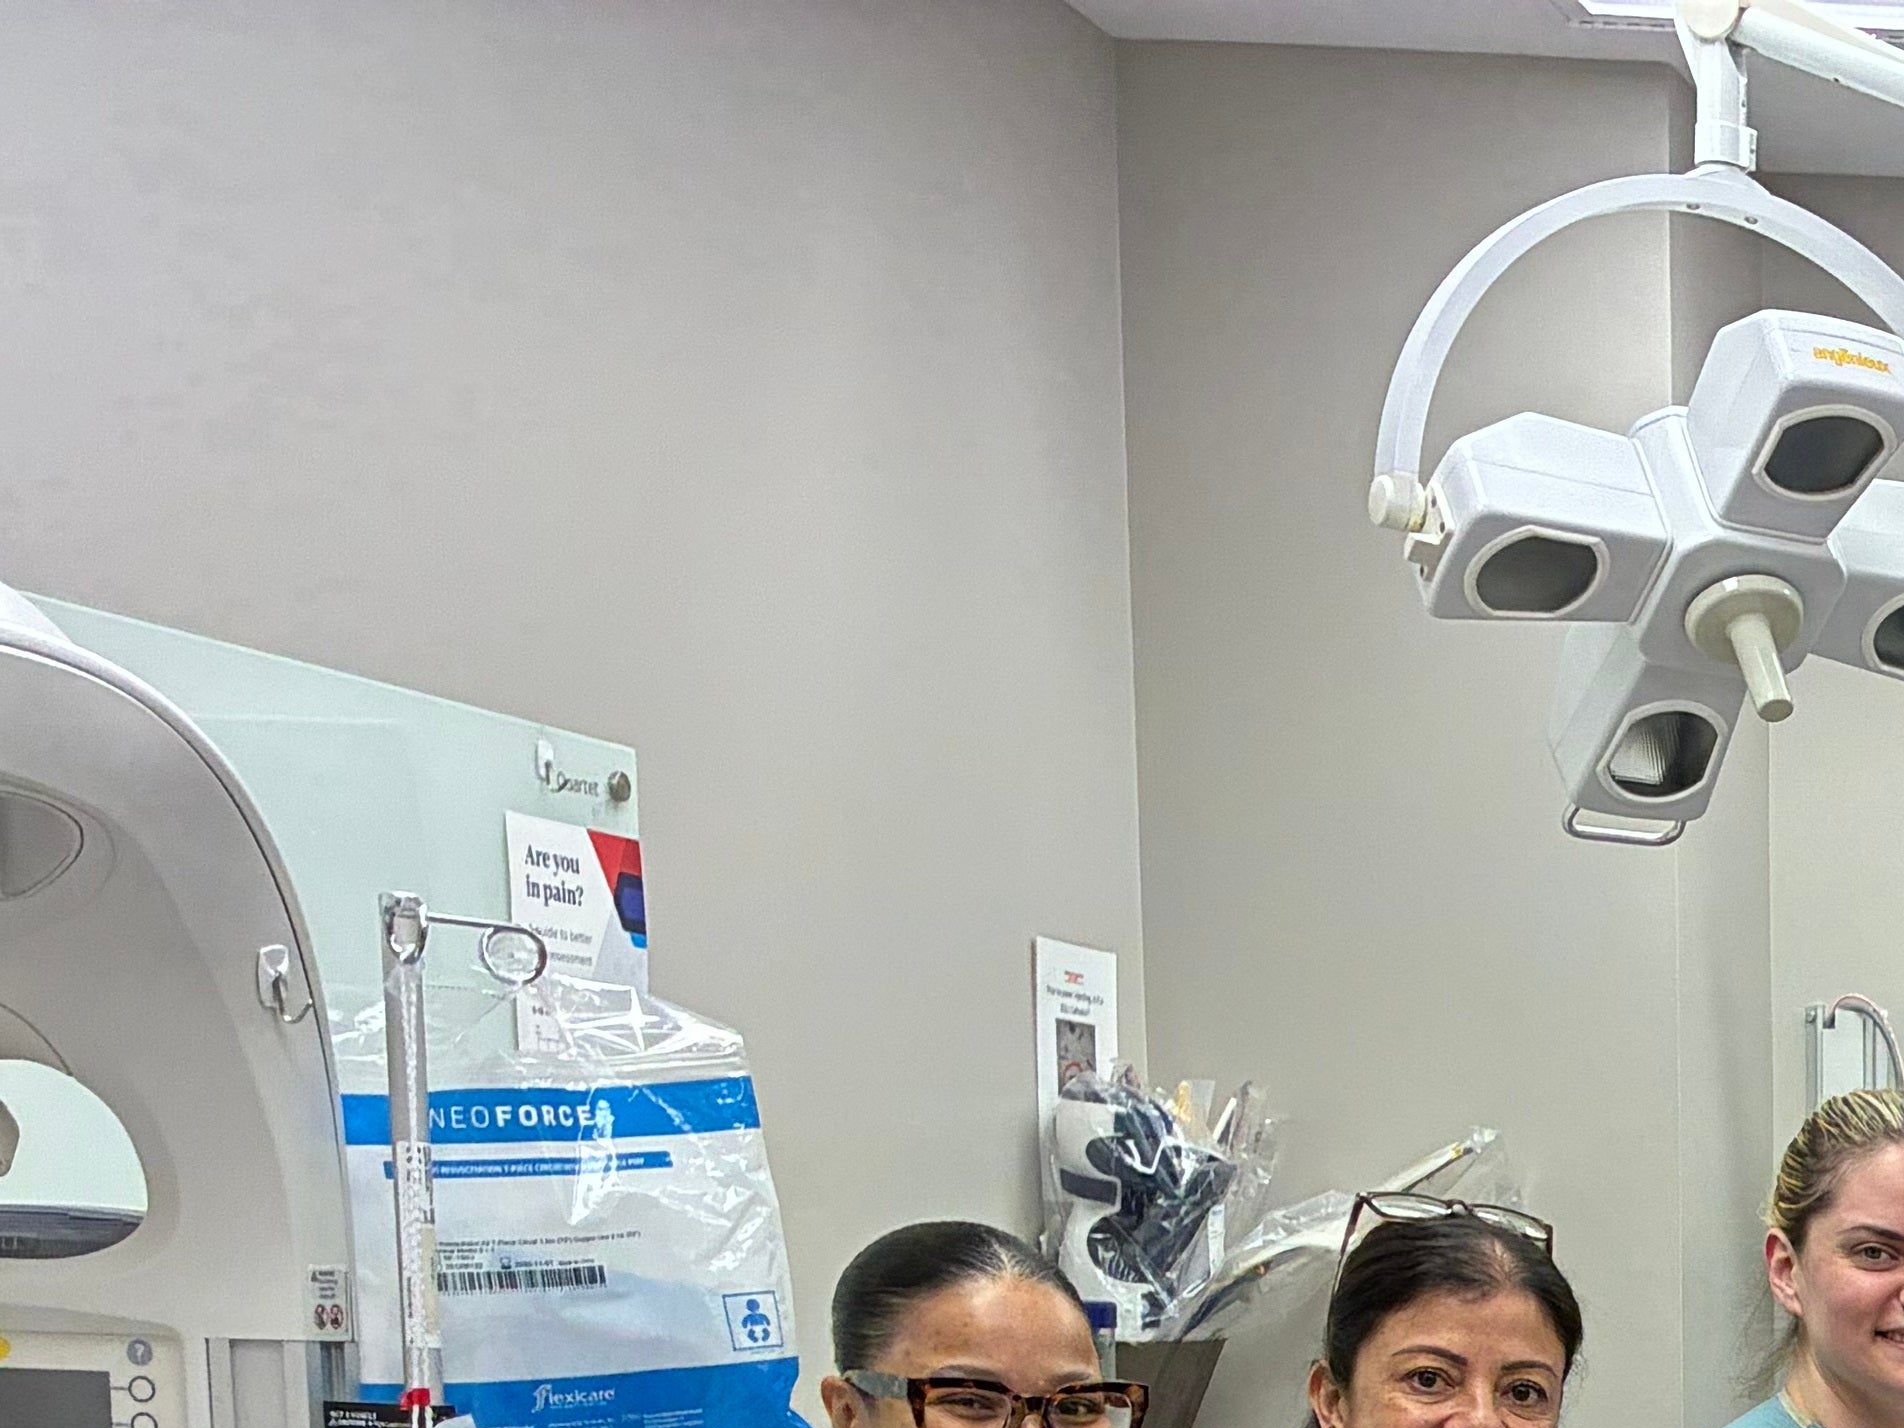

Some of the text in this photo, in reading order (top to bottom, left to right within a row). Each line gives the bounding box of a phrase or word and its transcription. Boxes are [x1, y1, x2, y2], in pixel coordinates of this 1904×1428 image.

[525, 844, 581, 876] Are you
[525, 874, 584, 907] in pain?
[429, 1104, 596, 1130] NEOFORCE
